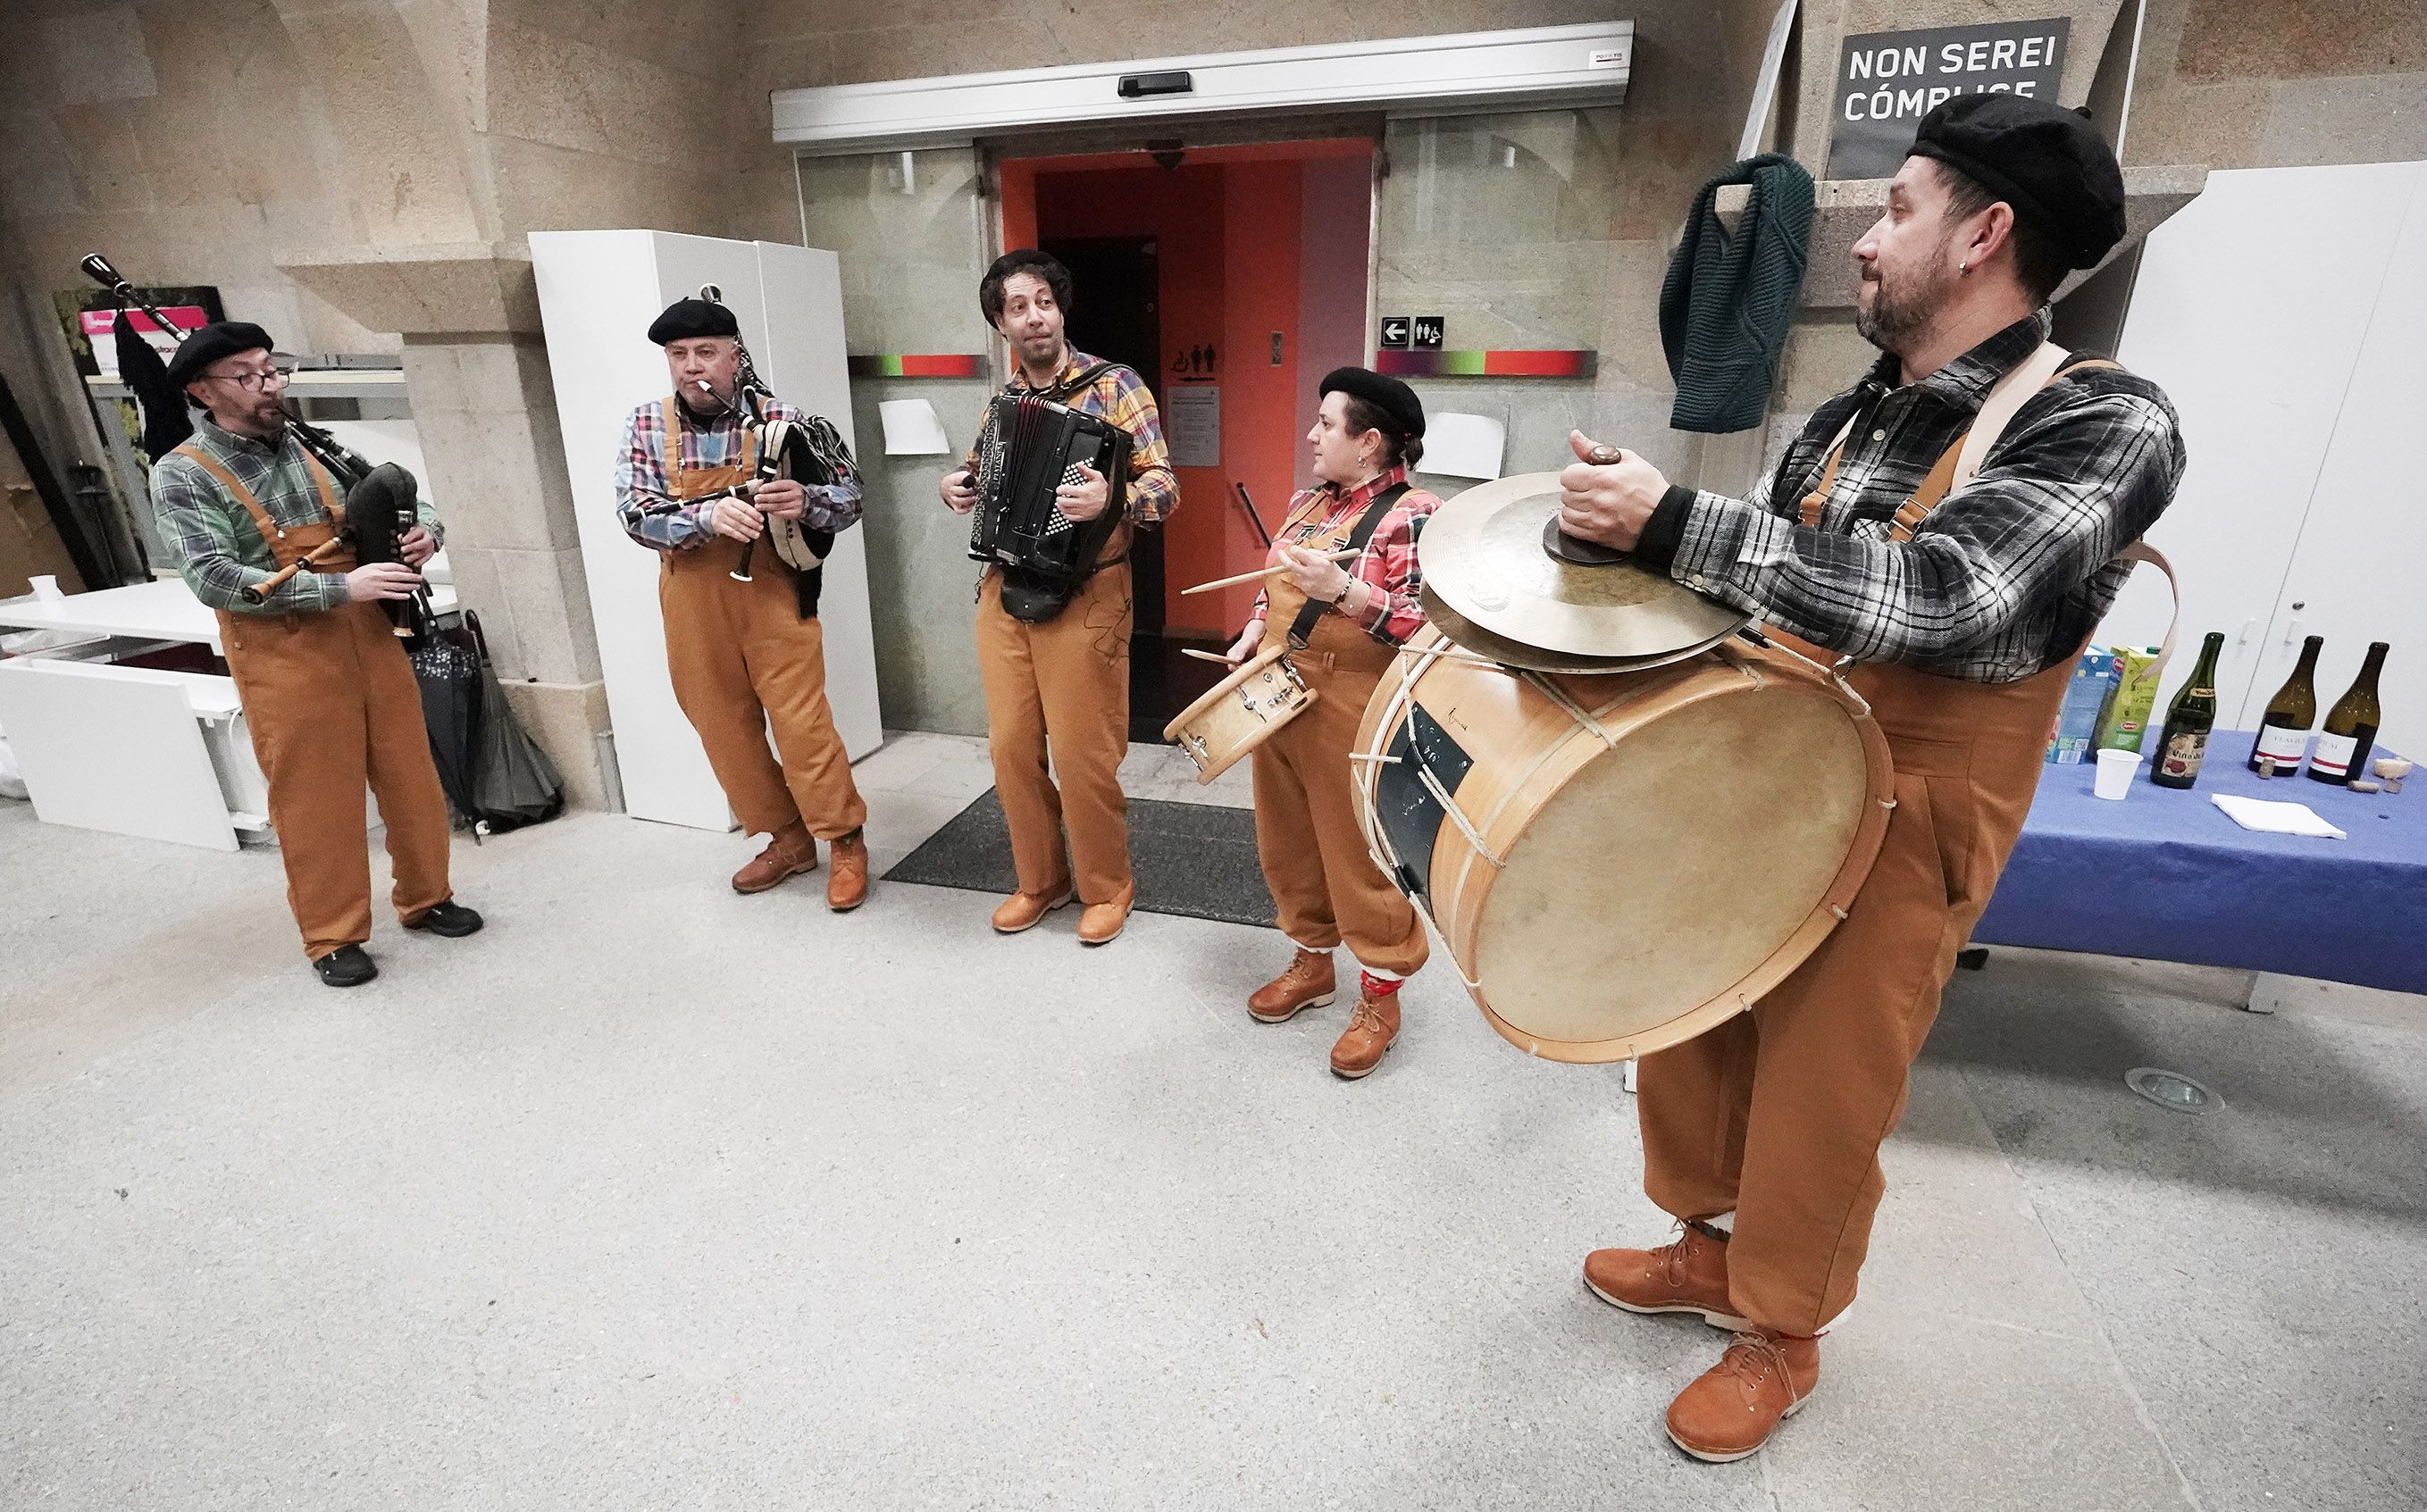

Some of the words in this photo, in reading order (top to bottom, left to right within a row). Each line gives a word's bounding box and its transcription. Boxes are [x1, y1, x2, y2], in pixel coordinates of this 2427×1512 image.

[1849, 46, 1927, 79] NON
[1939, 36, 2056, 73] SEREI
[1845, 80, 2037, 121] CÓMPE
